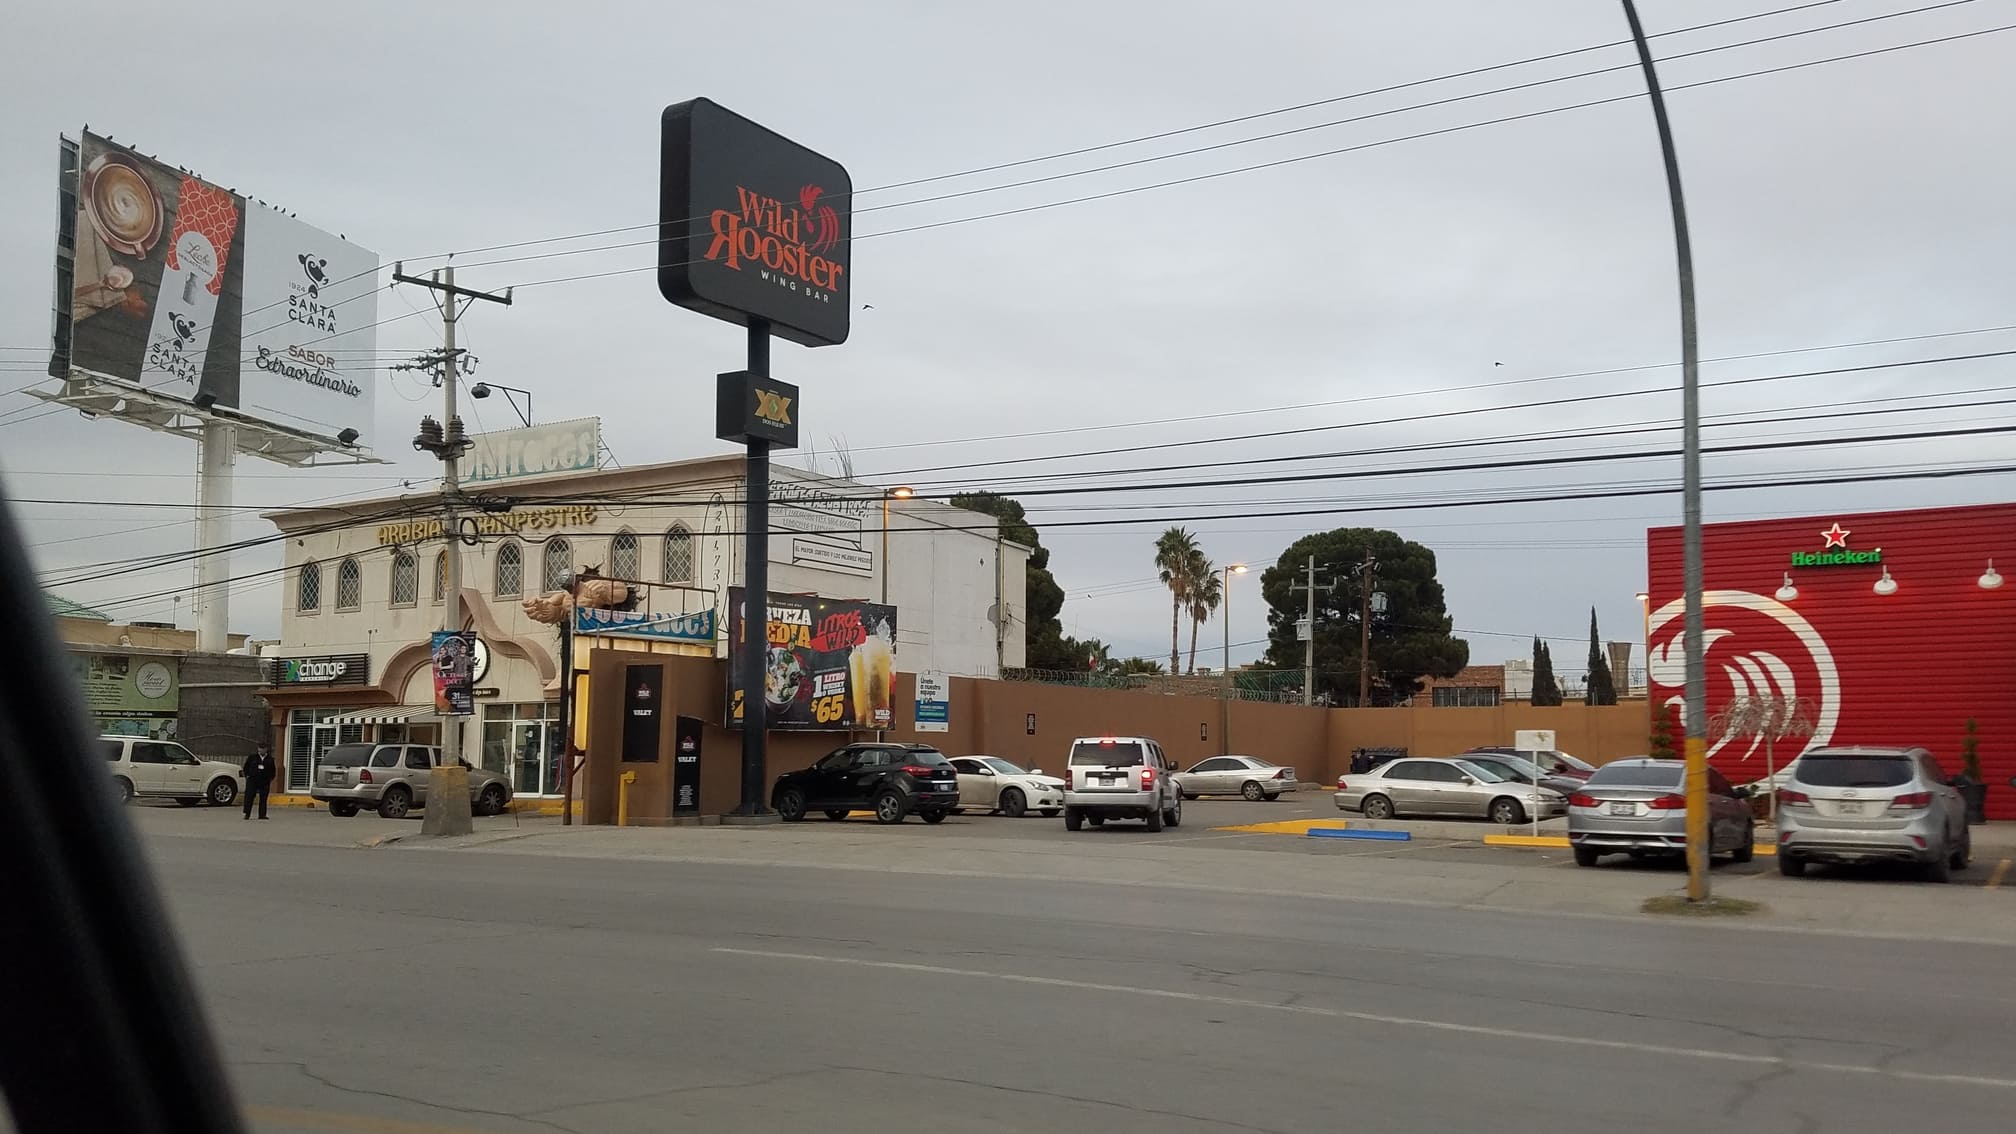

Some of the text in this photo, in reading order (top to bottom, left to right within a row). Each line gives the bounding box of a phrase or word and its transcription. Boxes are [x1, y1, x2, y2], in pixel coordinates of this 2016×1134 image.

[735, 185, 800, 245] Wild
[761, 270, 829, 304] WING BAR
[288, 294, 336, 321] SANTA
[288, 308, 336, 334] CLARA
[150, 354, 195, 385] CLARA
[152, 343, 197, 374] SANTA
[255, 345, 361, 398] Extraordinario
[288, 345, 336, 369] SABOR
[1791, 550, 1882, 567] Heineken
[741, 601, 812, 626] RVEZA
[740, 618, 812, 649] EDIA
[810, 695, 845, 723] $65
